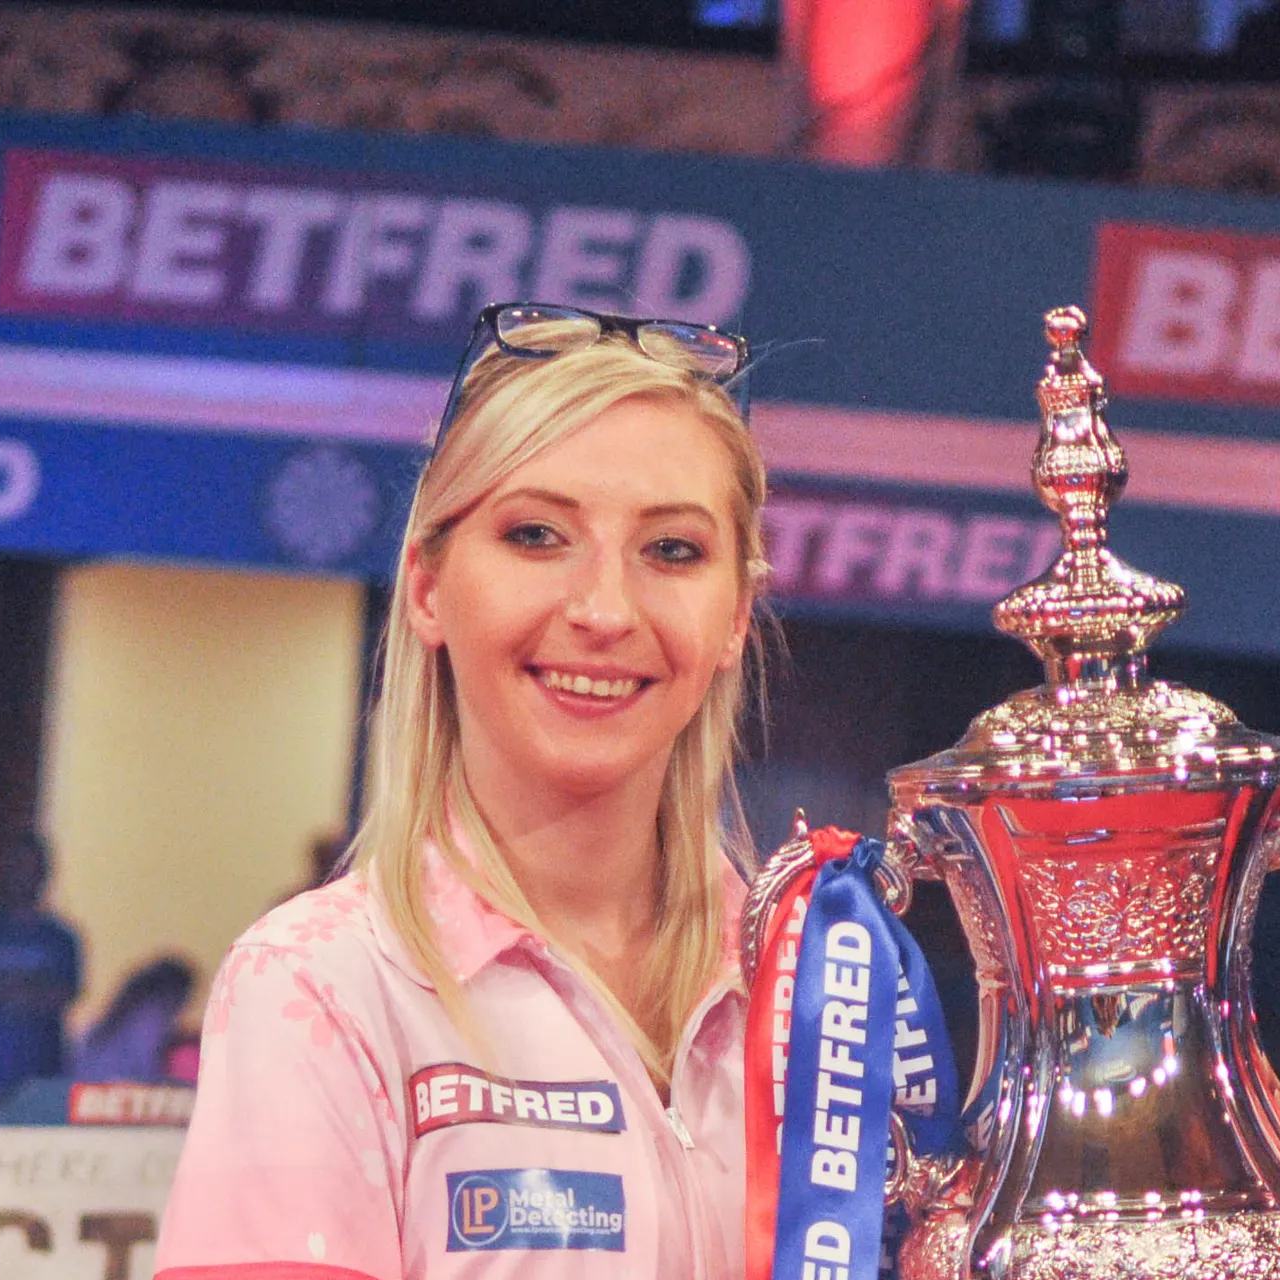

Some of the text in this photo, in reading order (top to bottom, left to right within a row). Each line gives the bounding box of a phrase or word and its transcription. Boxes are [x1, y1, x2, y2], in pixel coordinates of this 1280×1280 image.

[20, 170, 751, 322] BETFRED
[810, 920, 873, 1193] BETFRED
[414, 1073, 615, 1125] BETFRED
[461, 1186, 500, 1236] LP
[508, 1188, 575, 1208] Metal
[508, 1204, 623, 1233] Detecting
